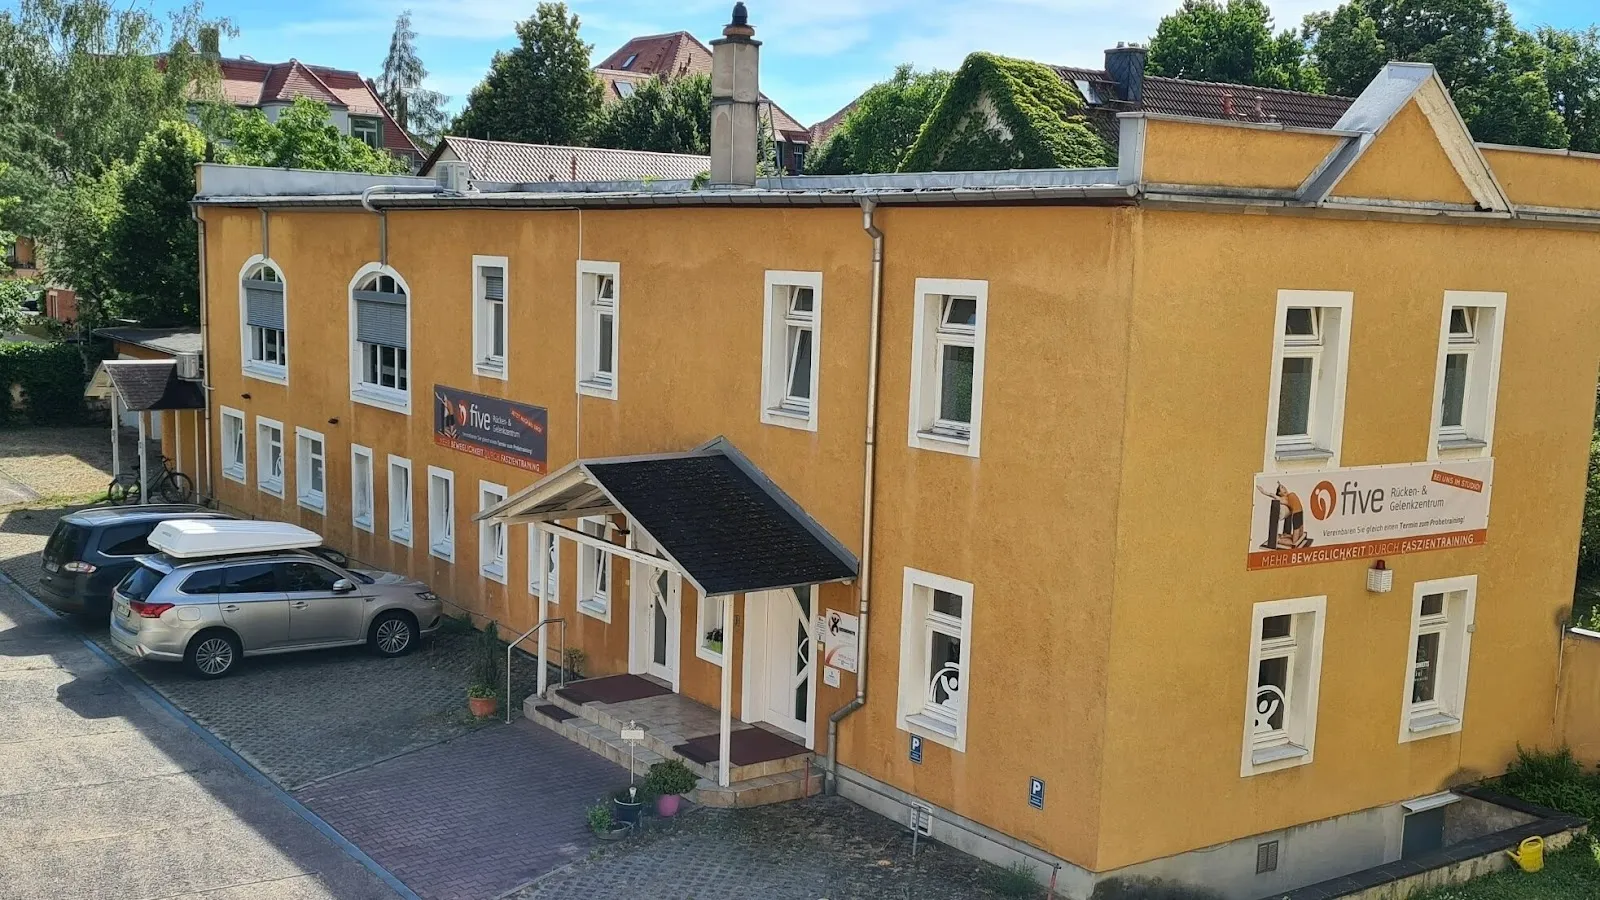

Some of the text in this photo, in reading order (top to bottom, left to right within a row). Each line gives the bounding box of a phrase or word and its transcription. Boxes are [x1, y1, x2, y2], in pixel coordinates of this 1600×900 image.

[470, 404, 490, 431] five
[1442, 475, 1453, 484] UNS
[1391, 485, 1428, 497] Rücken- &
[1341, 482, 1384, 516] five
[1390, 498, 1444, 511] Gelenkzentrum
[1323, 527, 1356, 537] Vereinbaren
[1357, 525, 1365, 533] Sie
[1366, 524, 1384, 534] gleich
[1430, 516, 1465, 526] Probetraining!
[1262, 534, 1474, 567] MEHR BEWEGLICHKEIT DURCH FASZIENTRAINING
[912, 738, 920, 750] P
[1032, 781, 1041, 794] P
